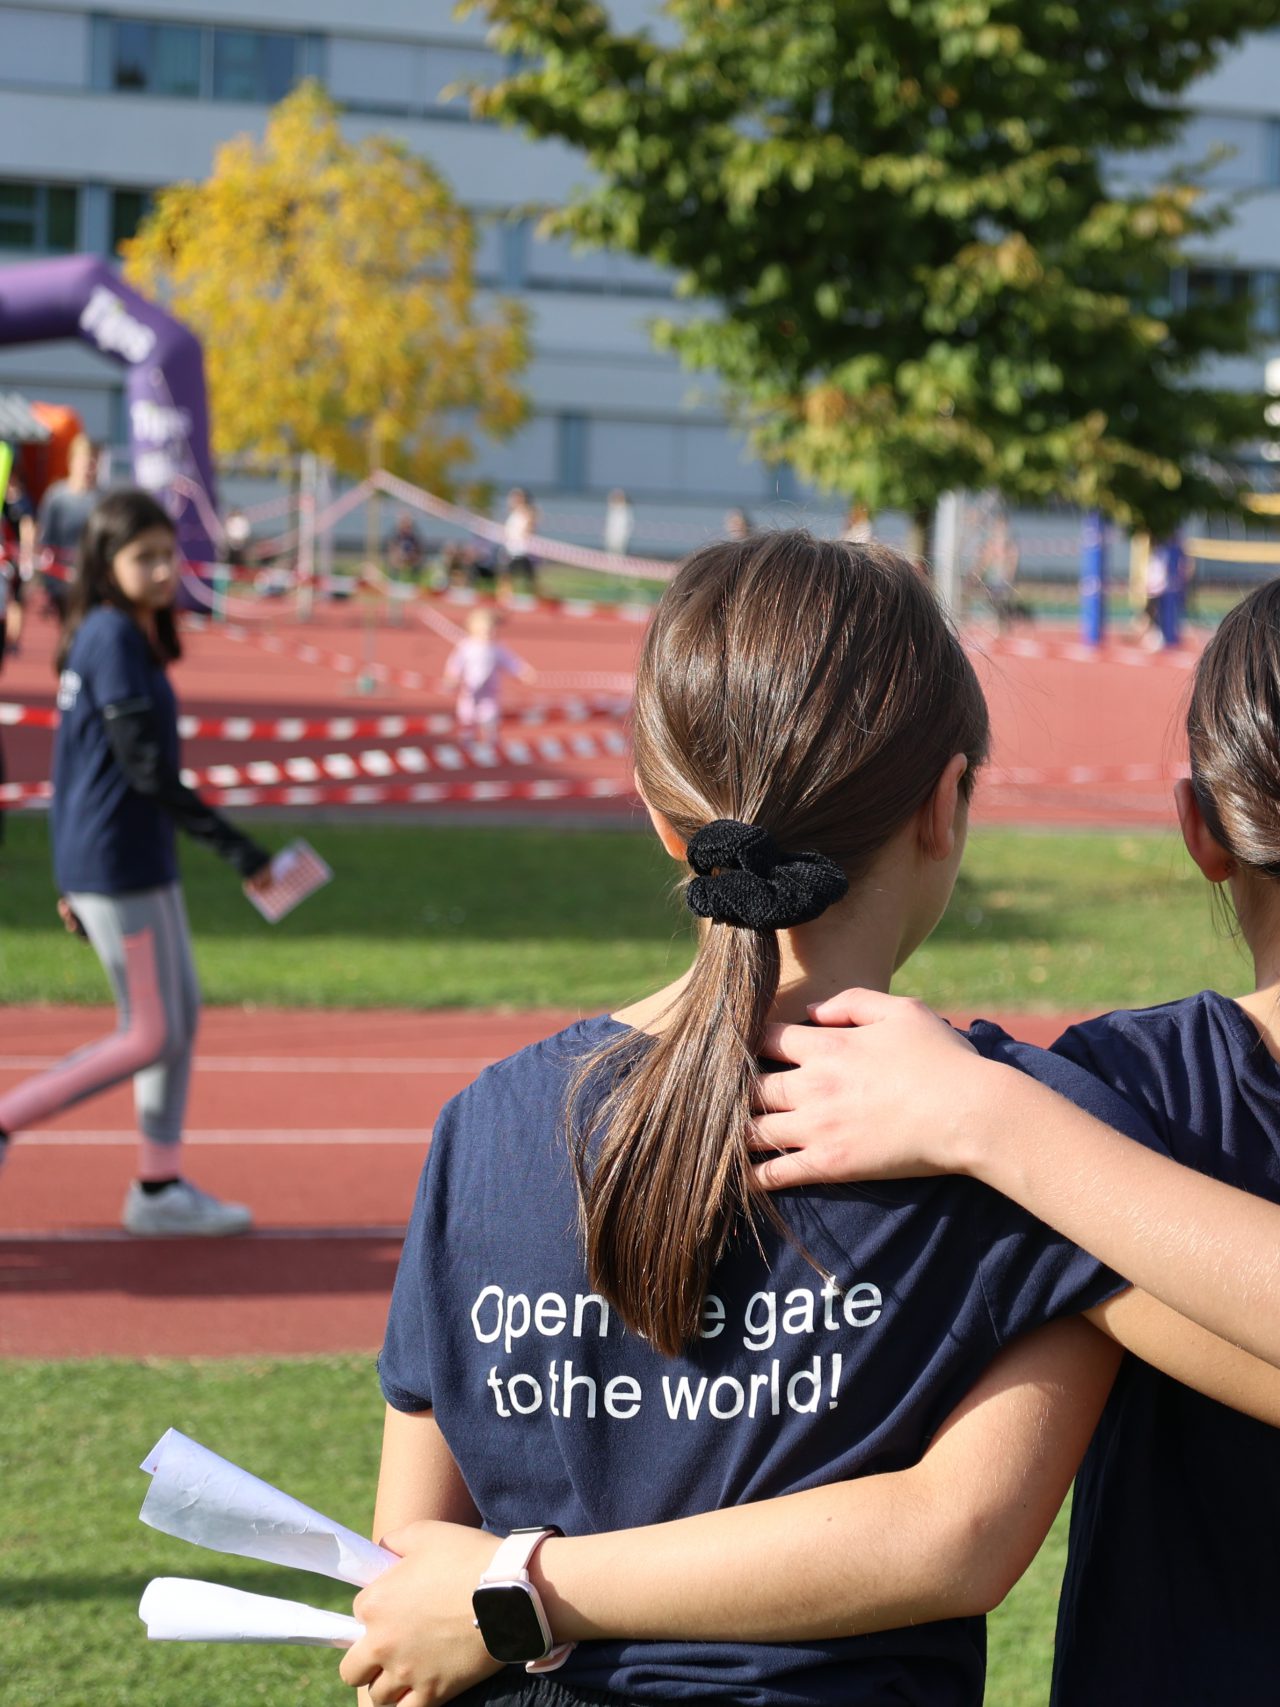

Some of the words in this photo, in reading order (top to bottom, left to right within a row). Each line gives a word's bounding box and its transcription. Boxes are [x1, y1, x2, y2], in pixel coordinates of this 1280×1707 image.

[470, 1284, 610, 1355] Open
[742, 1275, 883, 1352] gate
[661, 1352, 843, 1421] world!
